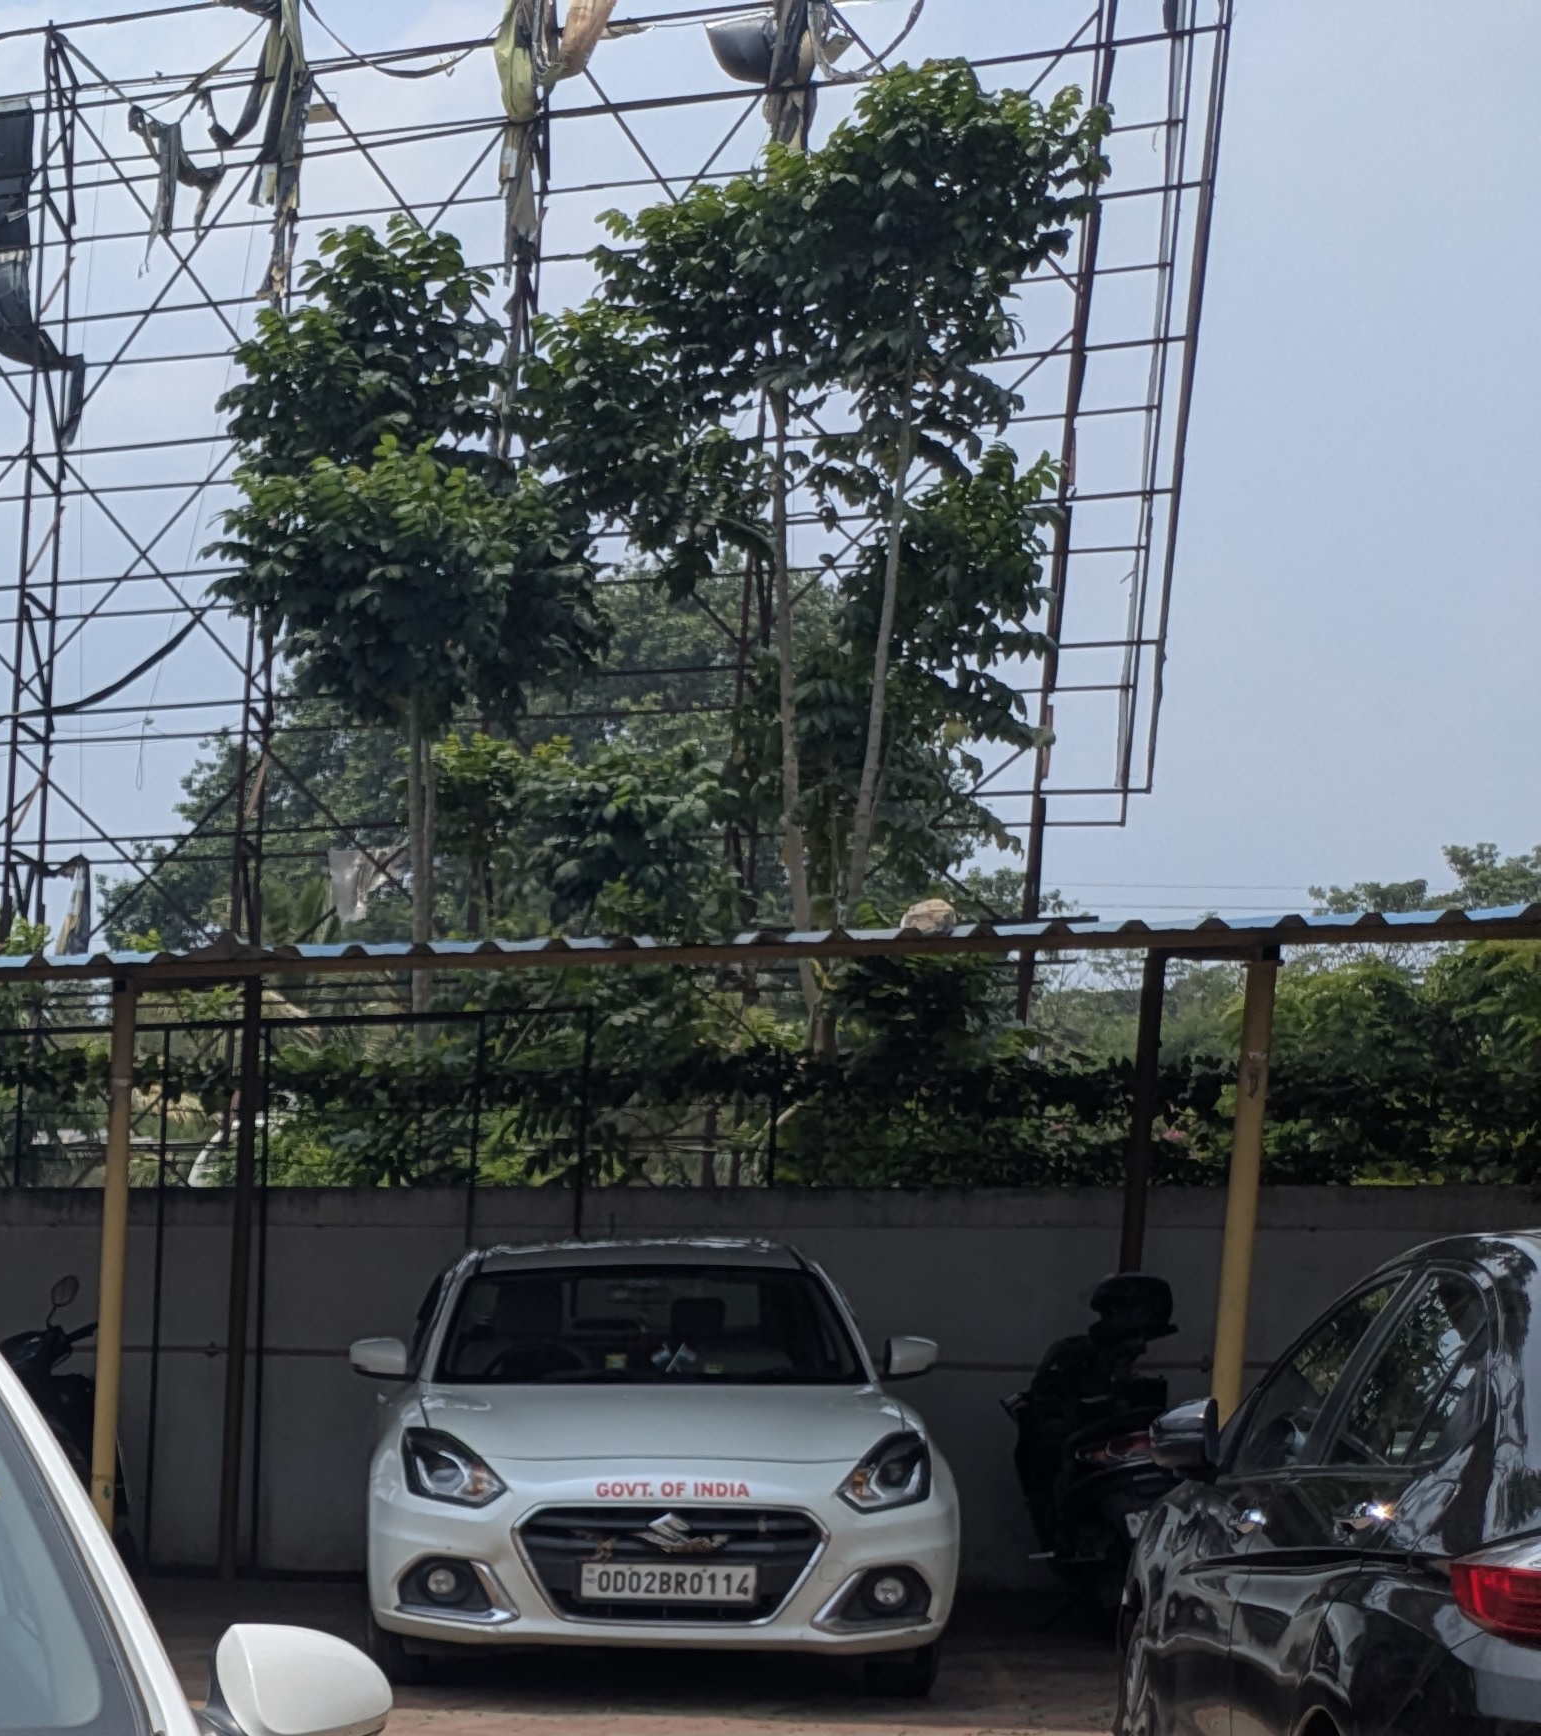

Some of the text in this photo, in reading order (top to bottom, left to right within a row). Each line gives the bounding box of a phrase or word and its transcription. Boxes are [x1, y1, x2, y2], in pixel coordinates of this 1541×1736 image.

[596, 1482, 750, 1498] GOVT. OF INDIA
